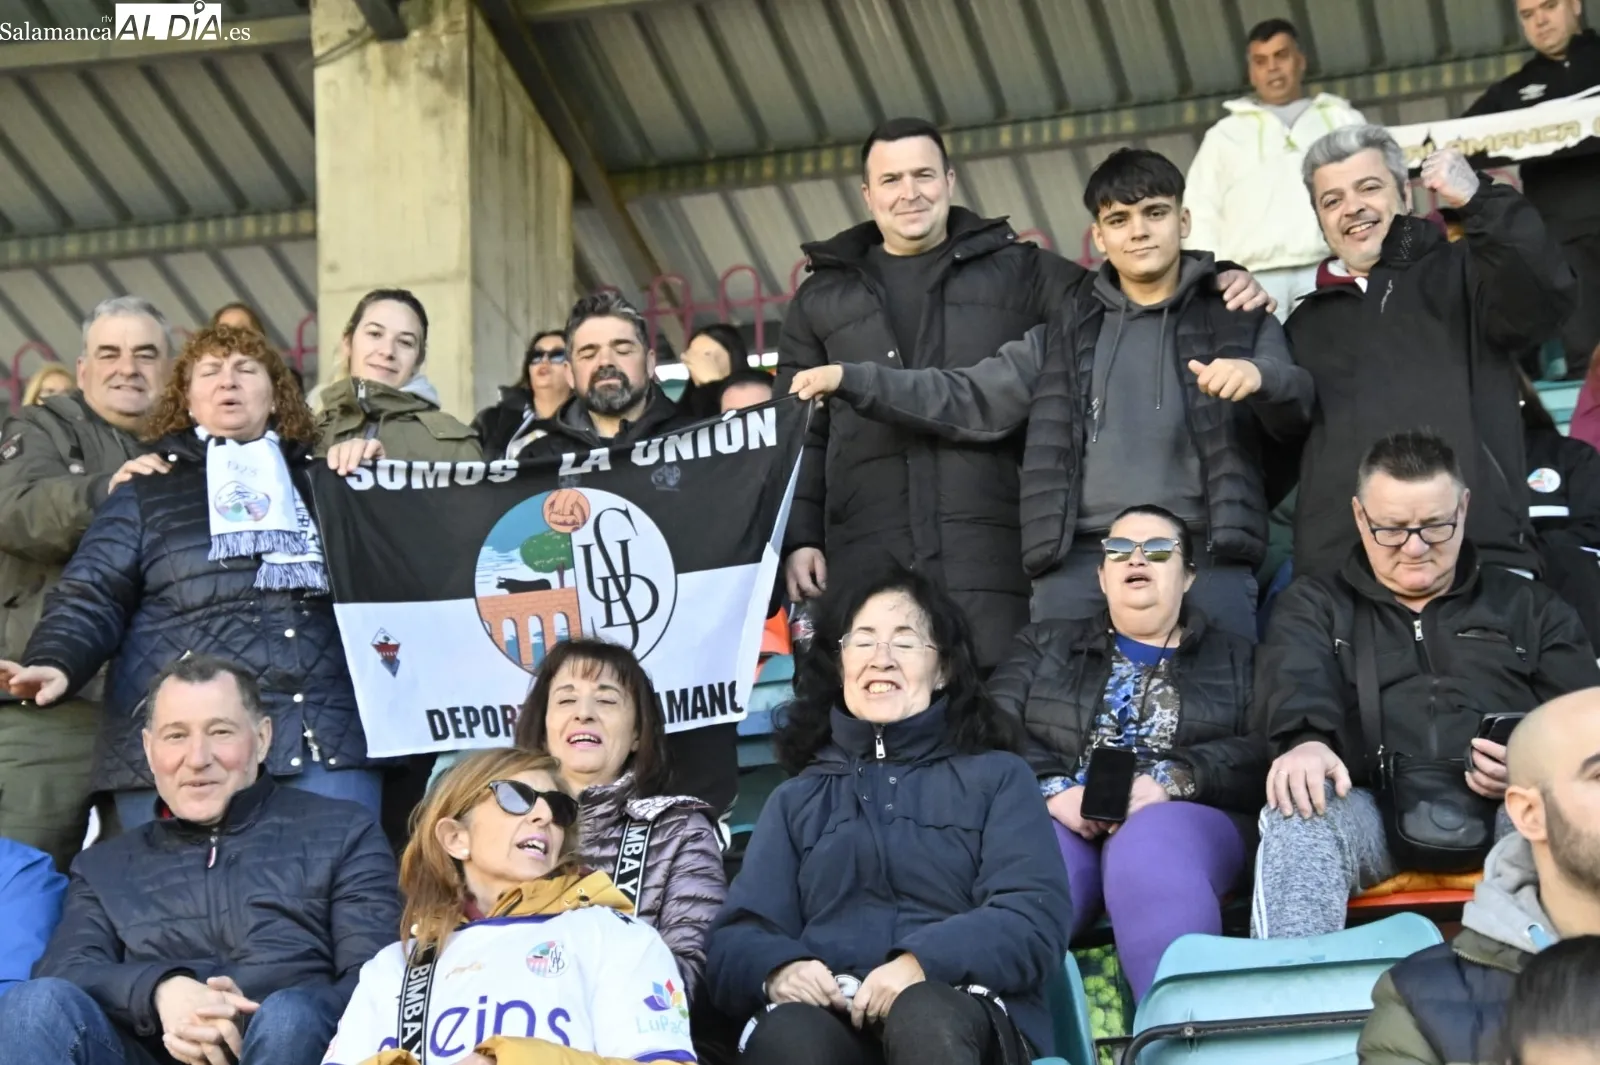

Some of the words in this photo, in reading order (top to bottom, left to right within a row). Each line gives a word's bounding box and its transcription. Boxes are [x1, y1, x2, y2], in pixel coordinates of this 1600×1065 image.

[345, 459, 519, 491] SOMOS
[558, 447, 612, 476] LA
[630, 407, 777, 466] UNIÓN
[425, 704, 524, 742] DEPOR
[402, 963, 432, 1044] BIMBA
